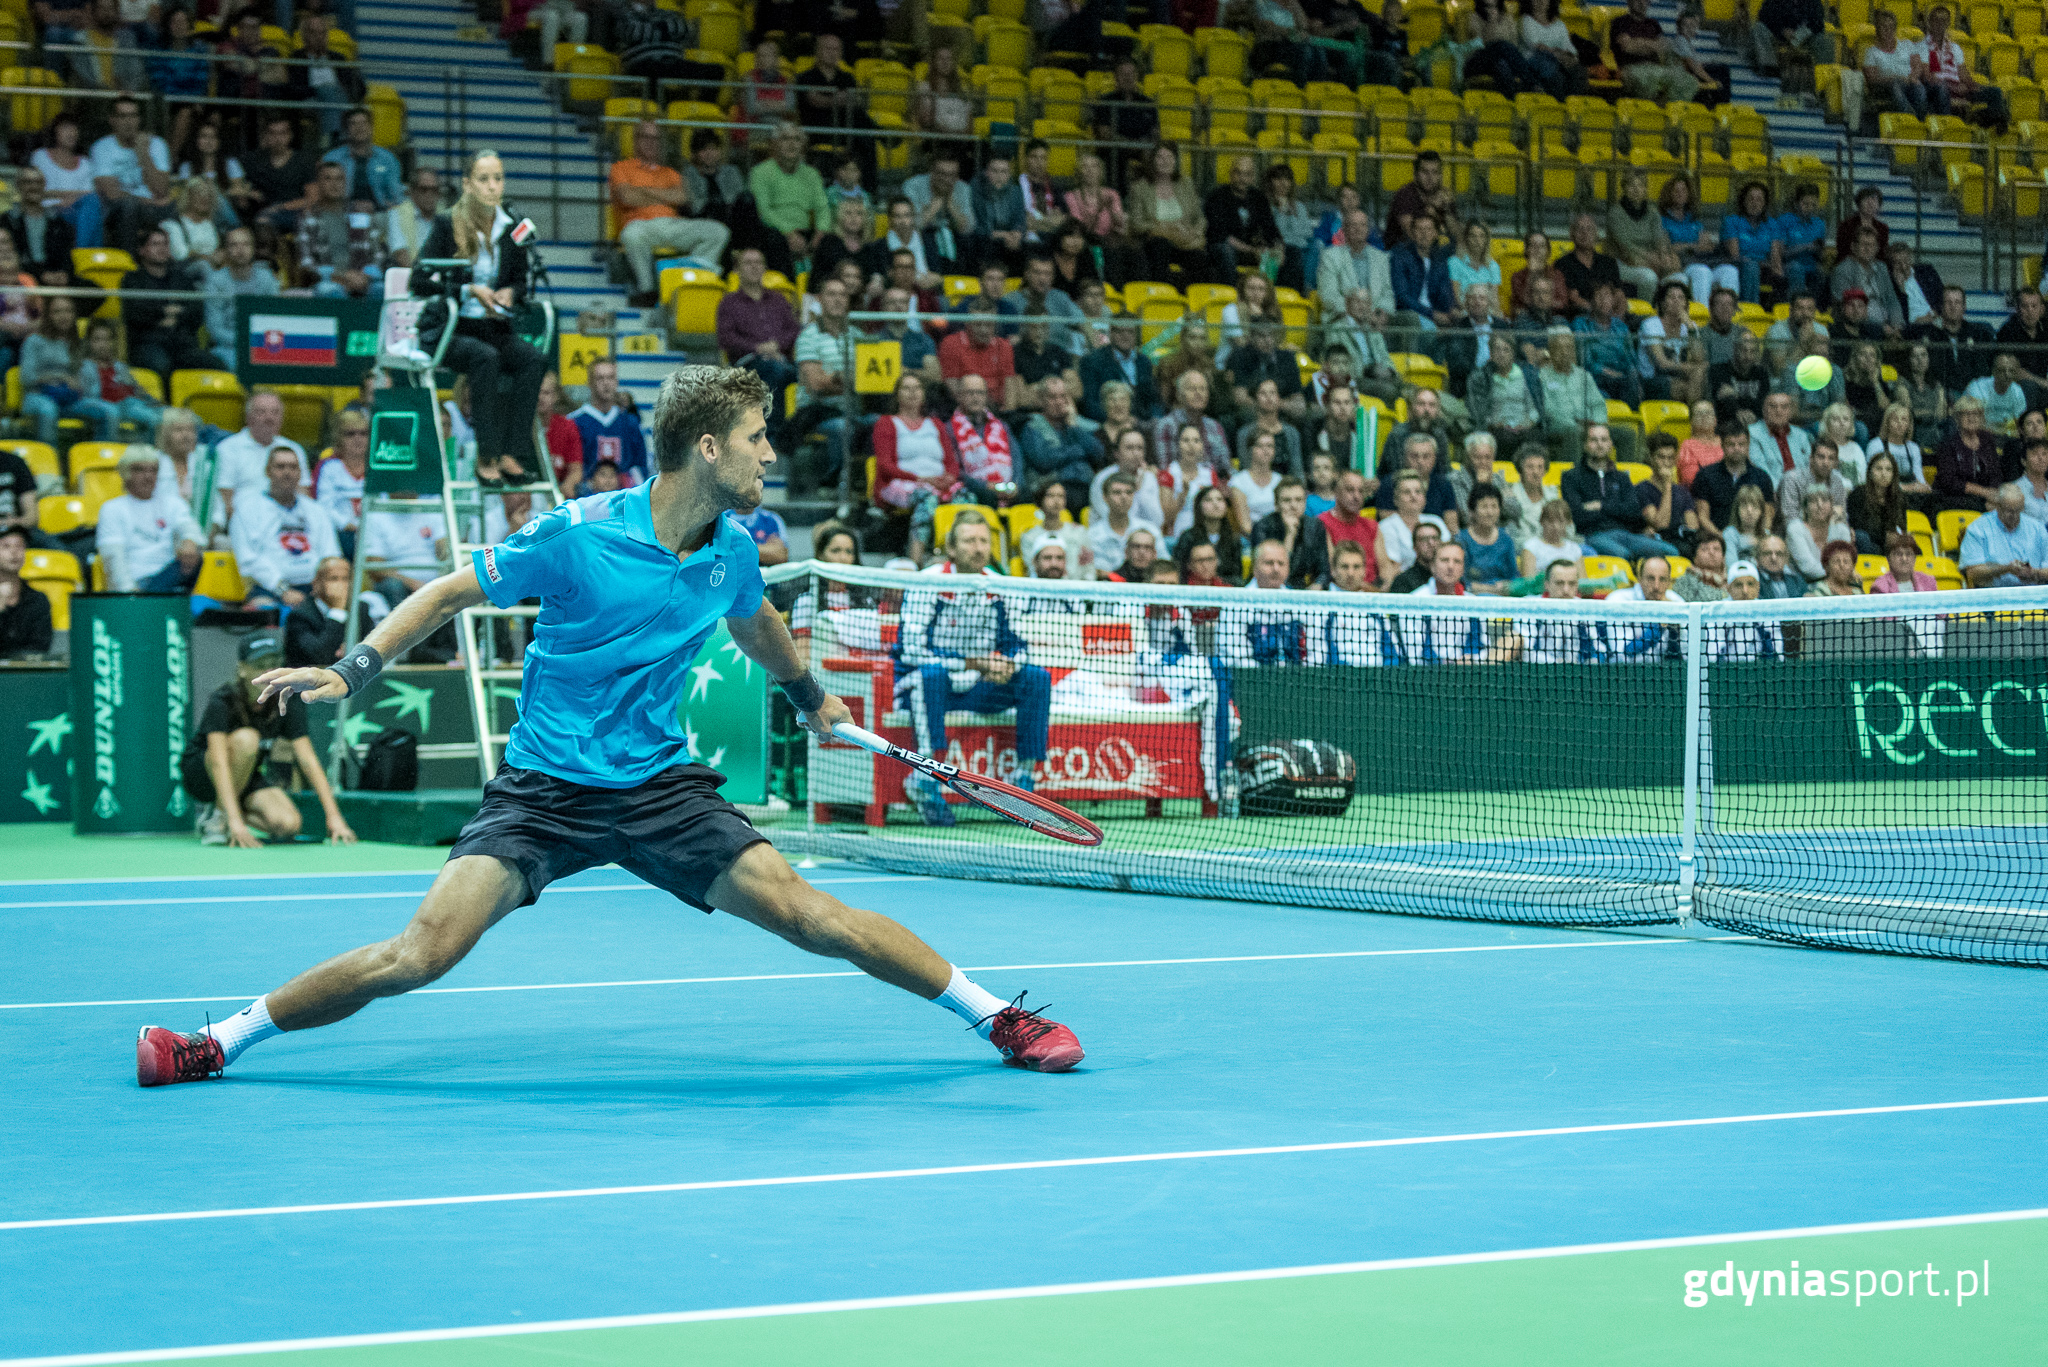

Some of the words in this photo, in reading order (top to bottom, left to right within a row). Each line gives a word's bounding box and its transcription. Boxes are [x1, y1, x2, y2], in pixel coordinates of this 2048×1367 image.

[865, 356, 893, 377] A1
[92, 615, 116, 786] DUNLOP
[891, 745, 958, 776] HEAD
